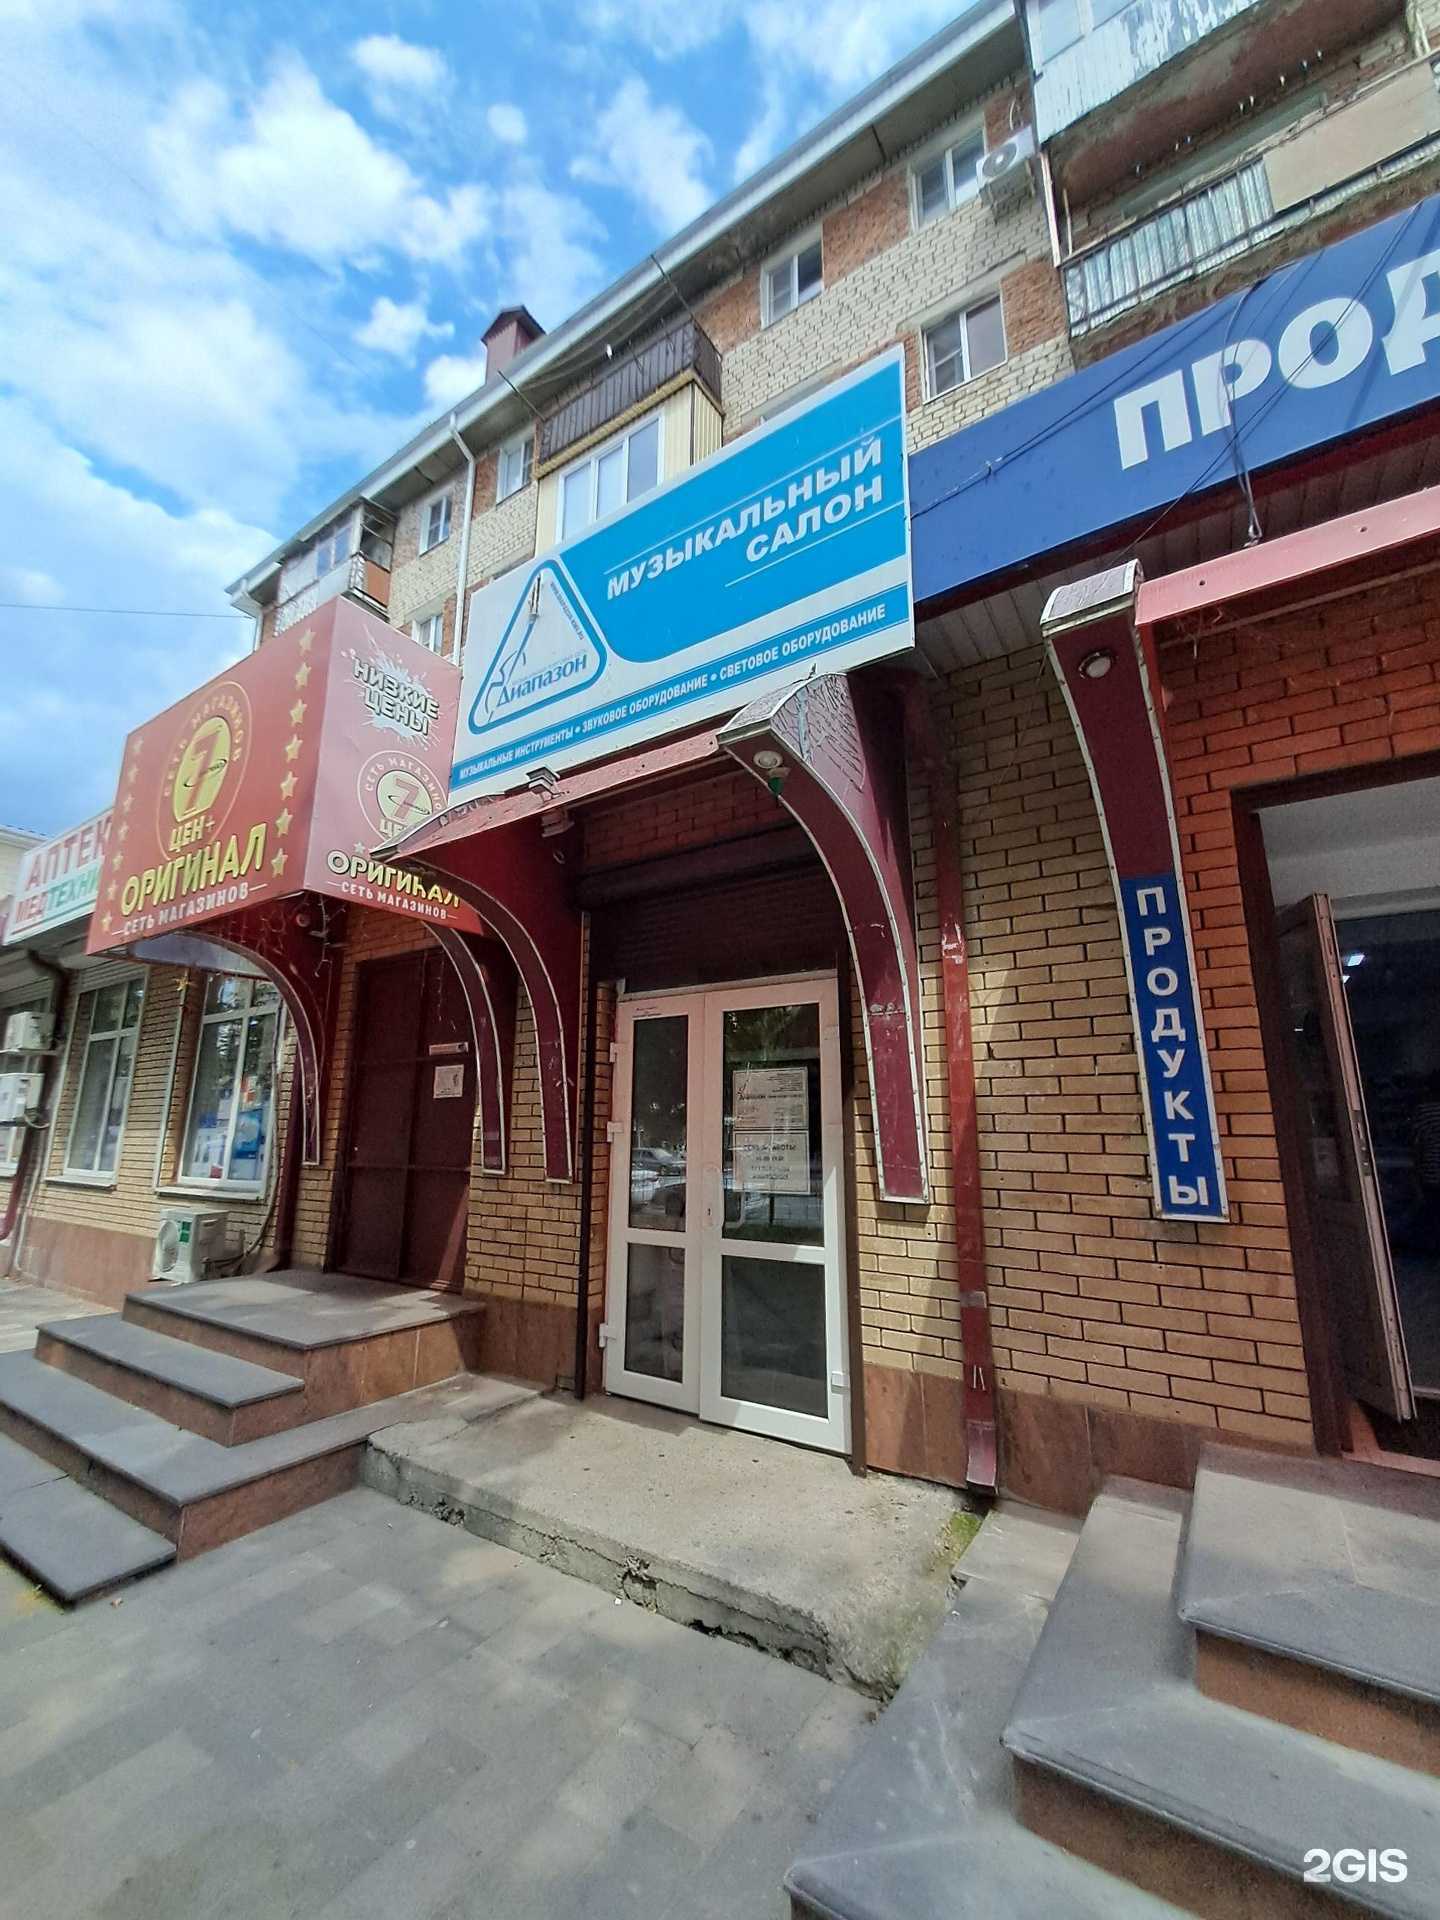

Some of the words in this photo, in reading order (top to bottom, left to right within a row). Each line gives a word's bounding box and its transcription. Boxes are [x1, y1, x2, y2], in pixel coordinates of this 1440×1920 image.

[607, 436, 881, 600] МУЗЫКАЛЬНЫЙ
[746, 474, 882, 562] САЛОН
[352, 656, 440, 720] НИЗКИЕ
[365, 688, 429, 736] ЦЕНЫ
[459, 752, 513, 779] МУЗЫКАЛЬНЫЕ
[514, 727, 573, 760] ИНСТРУМЕНТЫ
[581, 707, 627, 733] ЗВУКОВОЕ
[629, 675, 708, 714] ОБОРУДОВАНИЕ
[719, 646, 779, 680] СВЕТОВОЕ
[782, 604, 886, 657] ОБОРУДОВАНИЕ
[497, 654, 588, 707] Диапазон
[388, 757, 443, 810] МАГАЗИНО
[120, 822, 268, 916] ОРИГИНАЛ
[341, 881, 373, 900] СЕТЬ
[377, 891, 447, 919] МАГАЗИНОВ
[123, 914, 155, 936] СЕТЬ
[158, 882, 249, 926] МАГАЗИНОВ
[1136, 886, 1209, 1206] ПРОДУКТЫ
